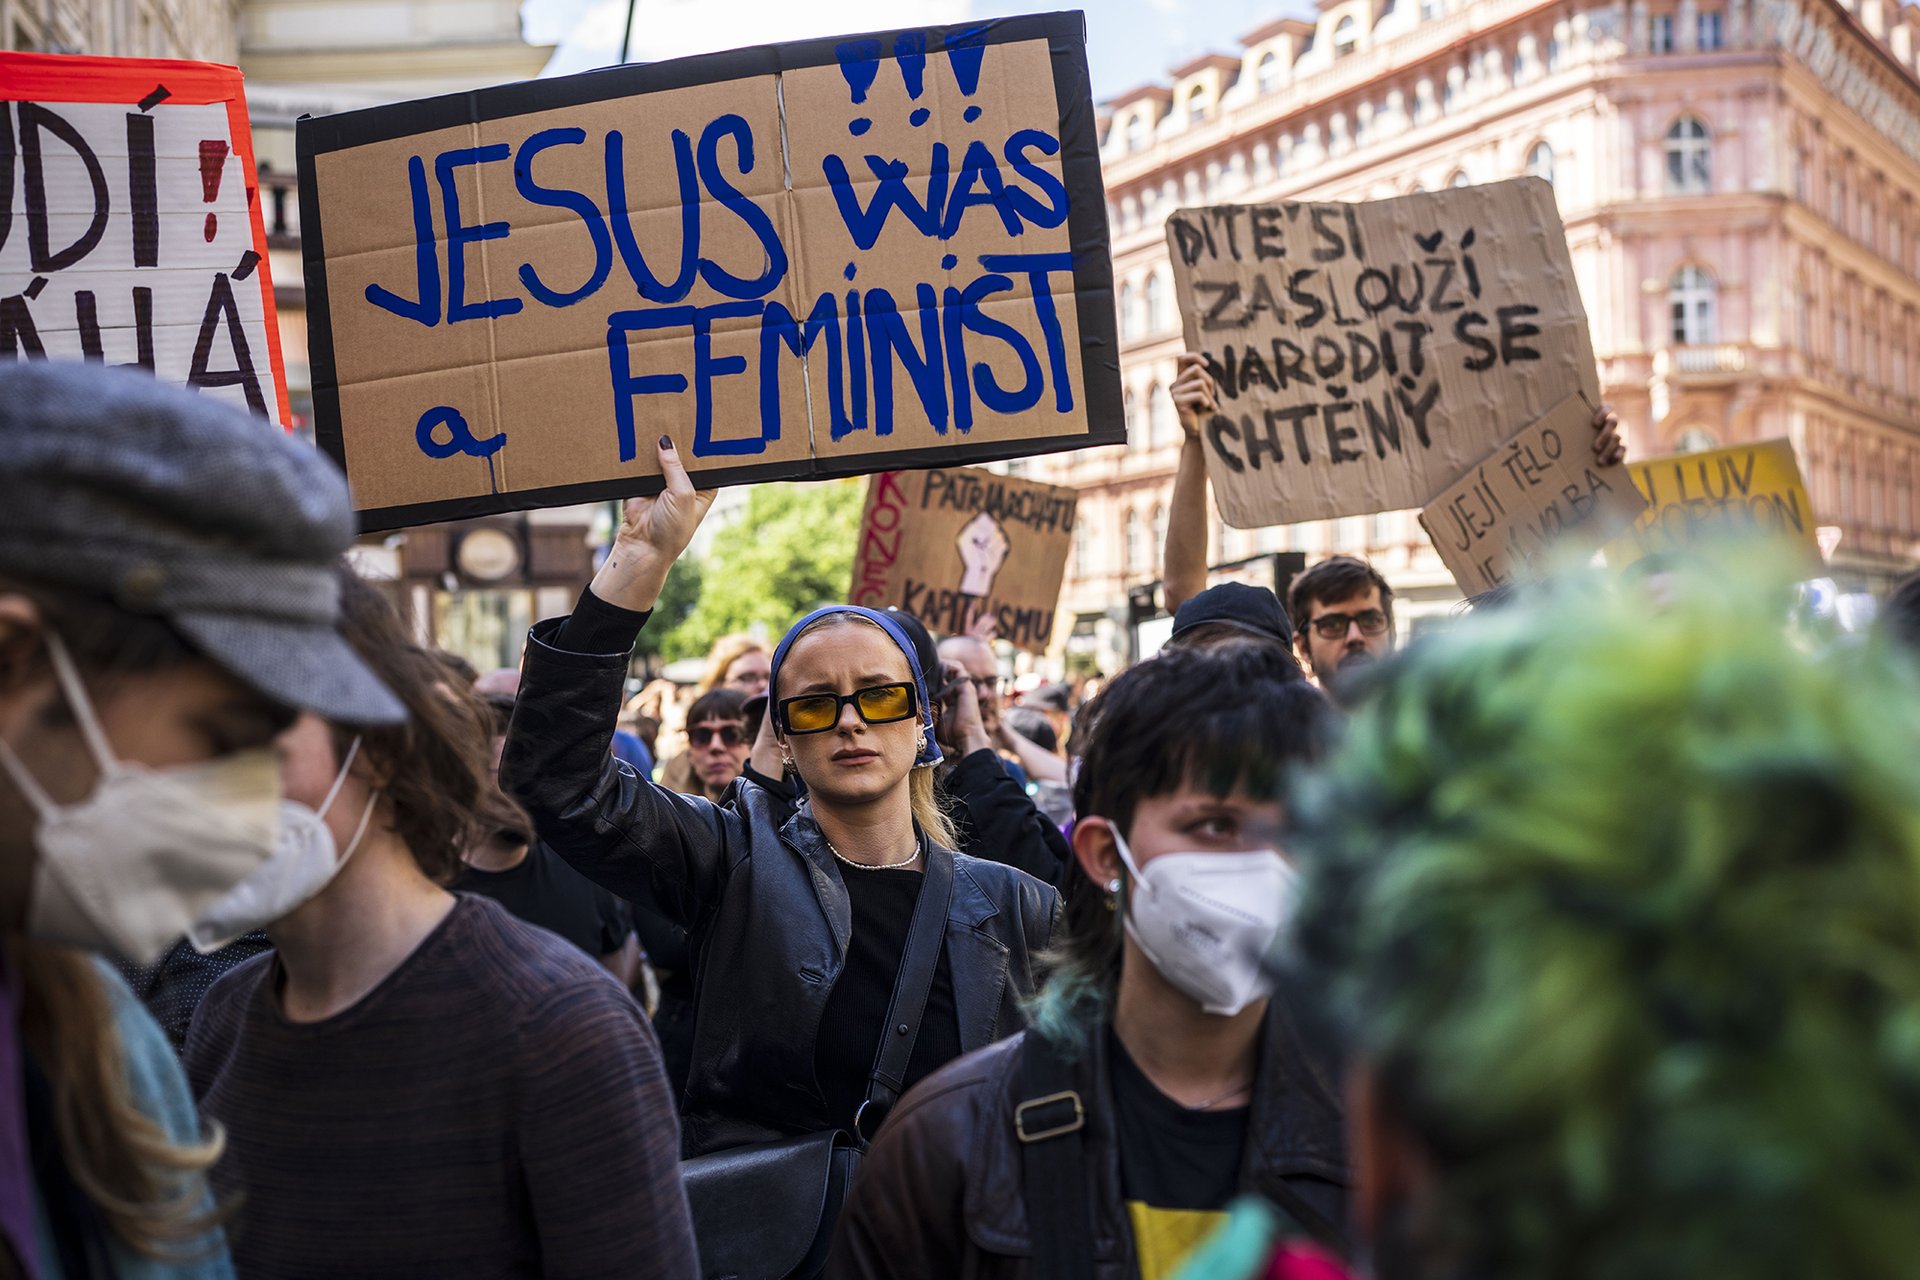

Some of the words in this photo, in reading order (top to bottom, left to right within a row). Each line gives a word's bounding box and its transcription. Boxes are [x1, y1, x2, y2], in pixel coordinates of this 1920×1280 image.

[0, 84, 229, 272] DÍ!
[365, 113, 789, 327] JESUS
[822, 129, 1070, 250] WAS
[1192, 227, 1482, 332] ZASLOUŽÍ
[1311, 204, 1365, 262] SI
[415, 405, 507, 462] a
[607, 253, 1079, 463] FEMINIST
[1201, 321, 1434, 401] NARODIT
[1454, 304, 1542, 372] SE
[1206, 377, 1441, 474] CHTĚNÝ
[1448, 466, 1507, 552] JEJÍ
[1501, 428, 1563, 491] TĚLO
[1674, 450, 1756, 503] LUV
[902, 578, 1055, 643] KAPITSMU
